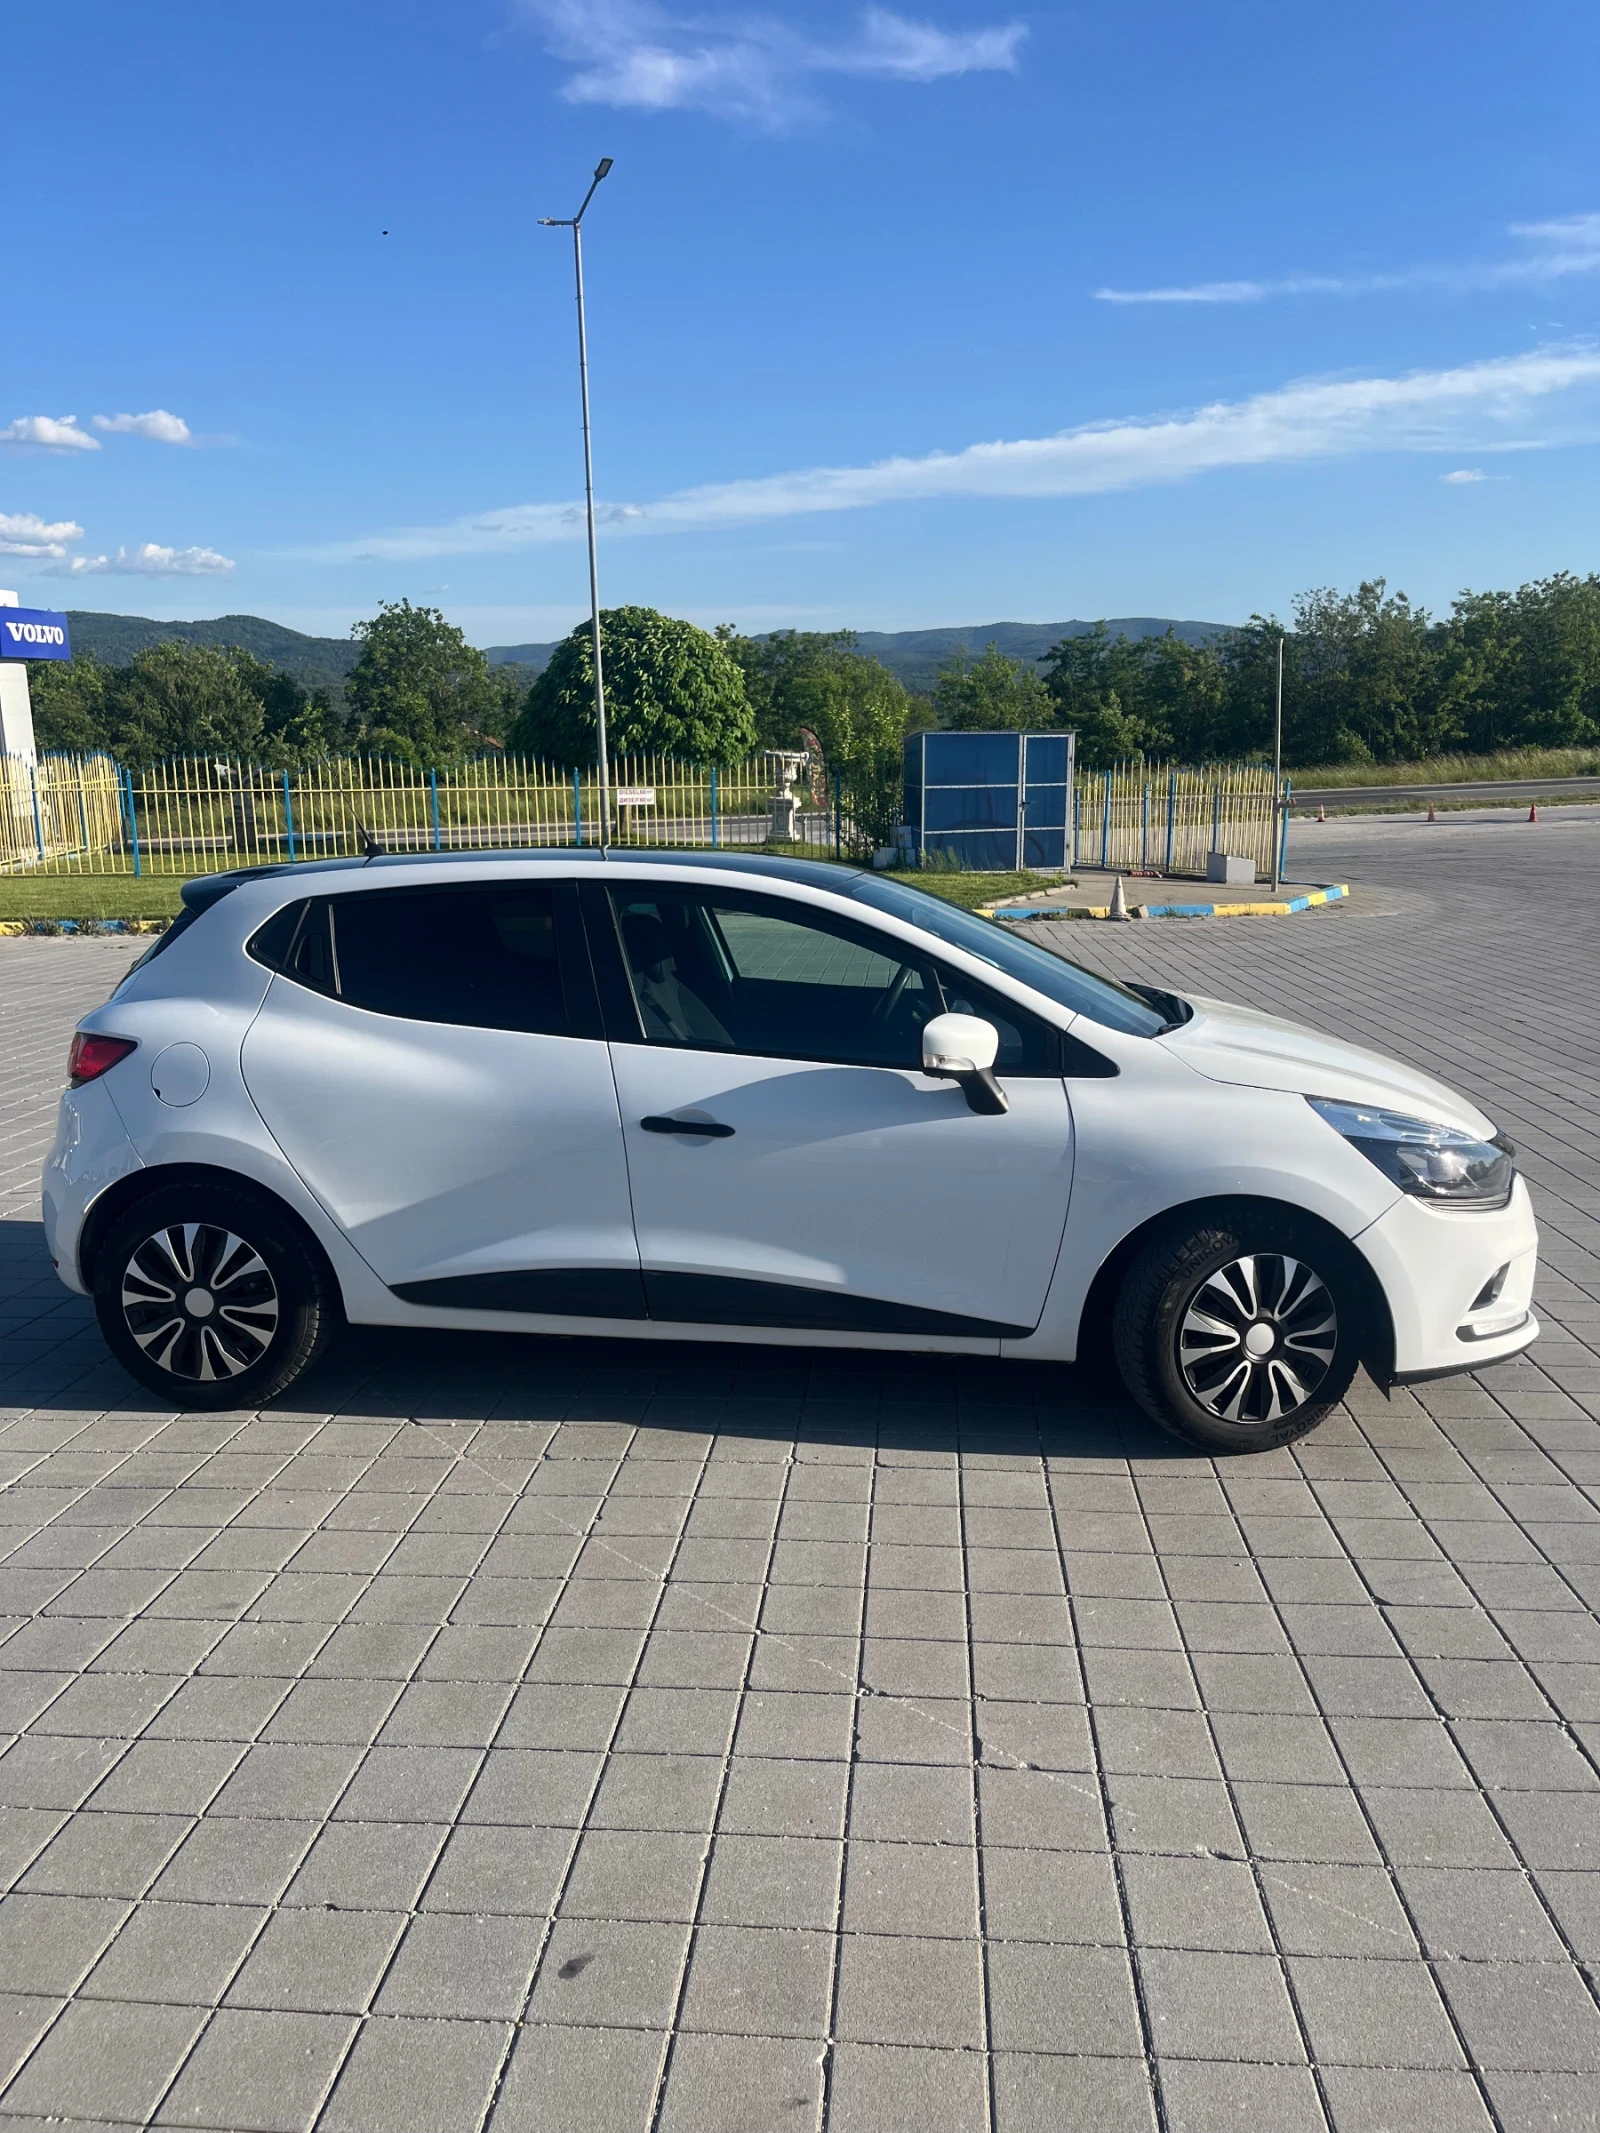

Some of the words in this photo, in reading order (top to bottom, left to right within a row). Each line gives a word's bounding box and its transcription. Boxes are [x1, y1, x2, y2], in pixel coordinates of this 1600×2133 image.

[5, 622, 64, 645] VOLVO
[1181, 1233, 1235, 1280] UNIROY
[1269, 1401, 1330, 1443] NIROYAL
